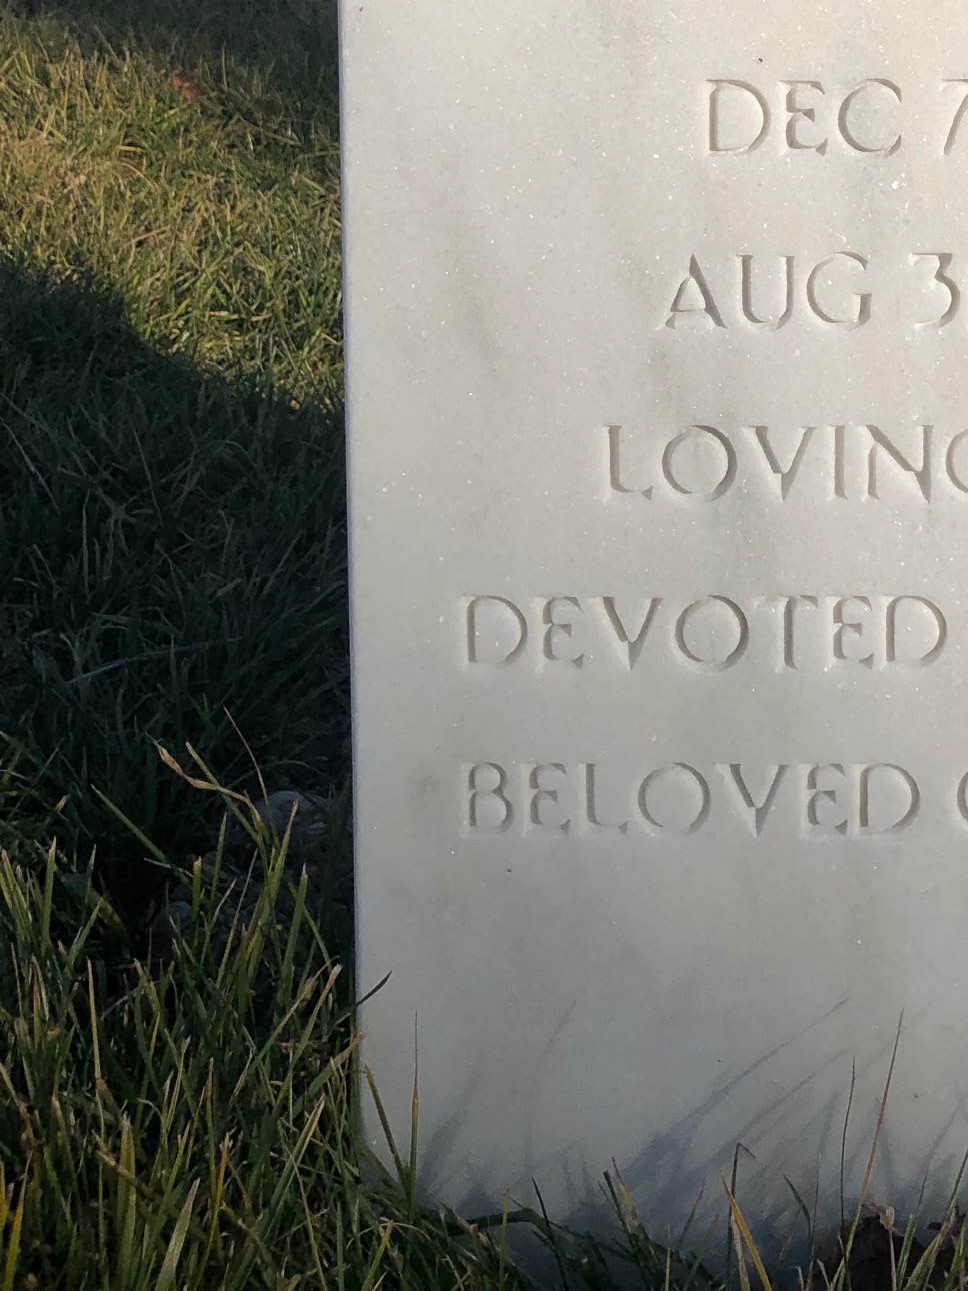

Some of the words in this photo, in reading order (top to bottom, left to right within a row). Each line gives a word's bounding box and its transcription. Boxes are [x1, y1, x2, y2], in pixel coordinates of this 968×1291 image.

[705, 77, 903, 158] DEC
[663, 250, 873, 330] AUG
[462, 594, 948, 672] DEVOTED
[462, 761, 920, 838] BELOVED
